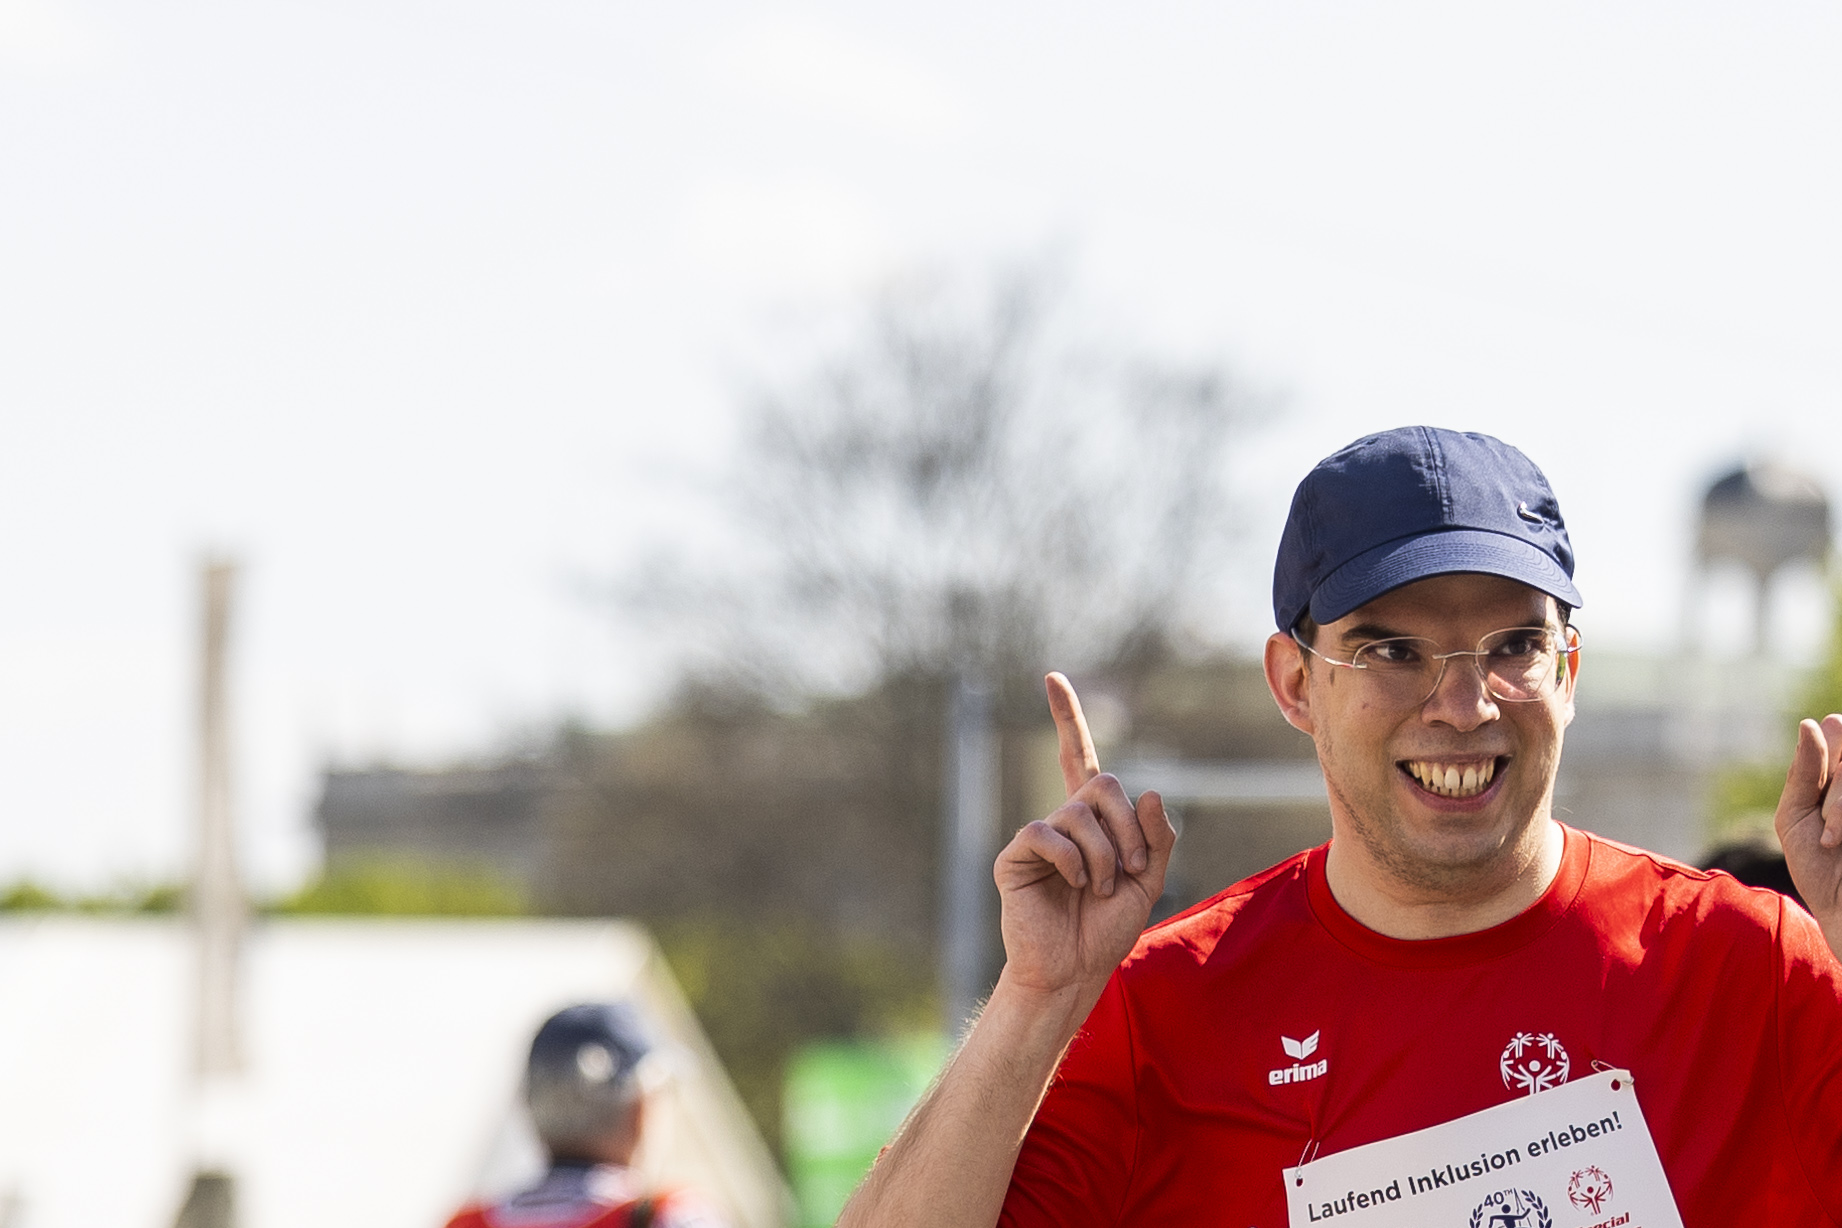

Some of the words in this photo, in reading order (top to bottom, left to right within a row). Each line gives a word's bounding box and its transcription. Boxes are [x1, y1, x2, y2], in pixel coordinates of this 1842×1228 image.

[1268, 1058, 1328, 1086] erima
[1308, 1180, 1401, 1222] Laufend
[1408, 1147, 1521, 1196] Inklusion
[1527, 1111, 1623, 1158] erleben!
